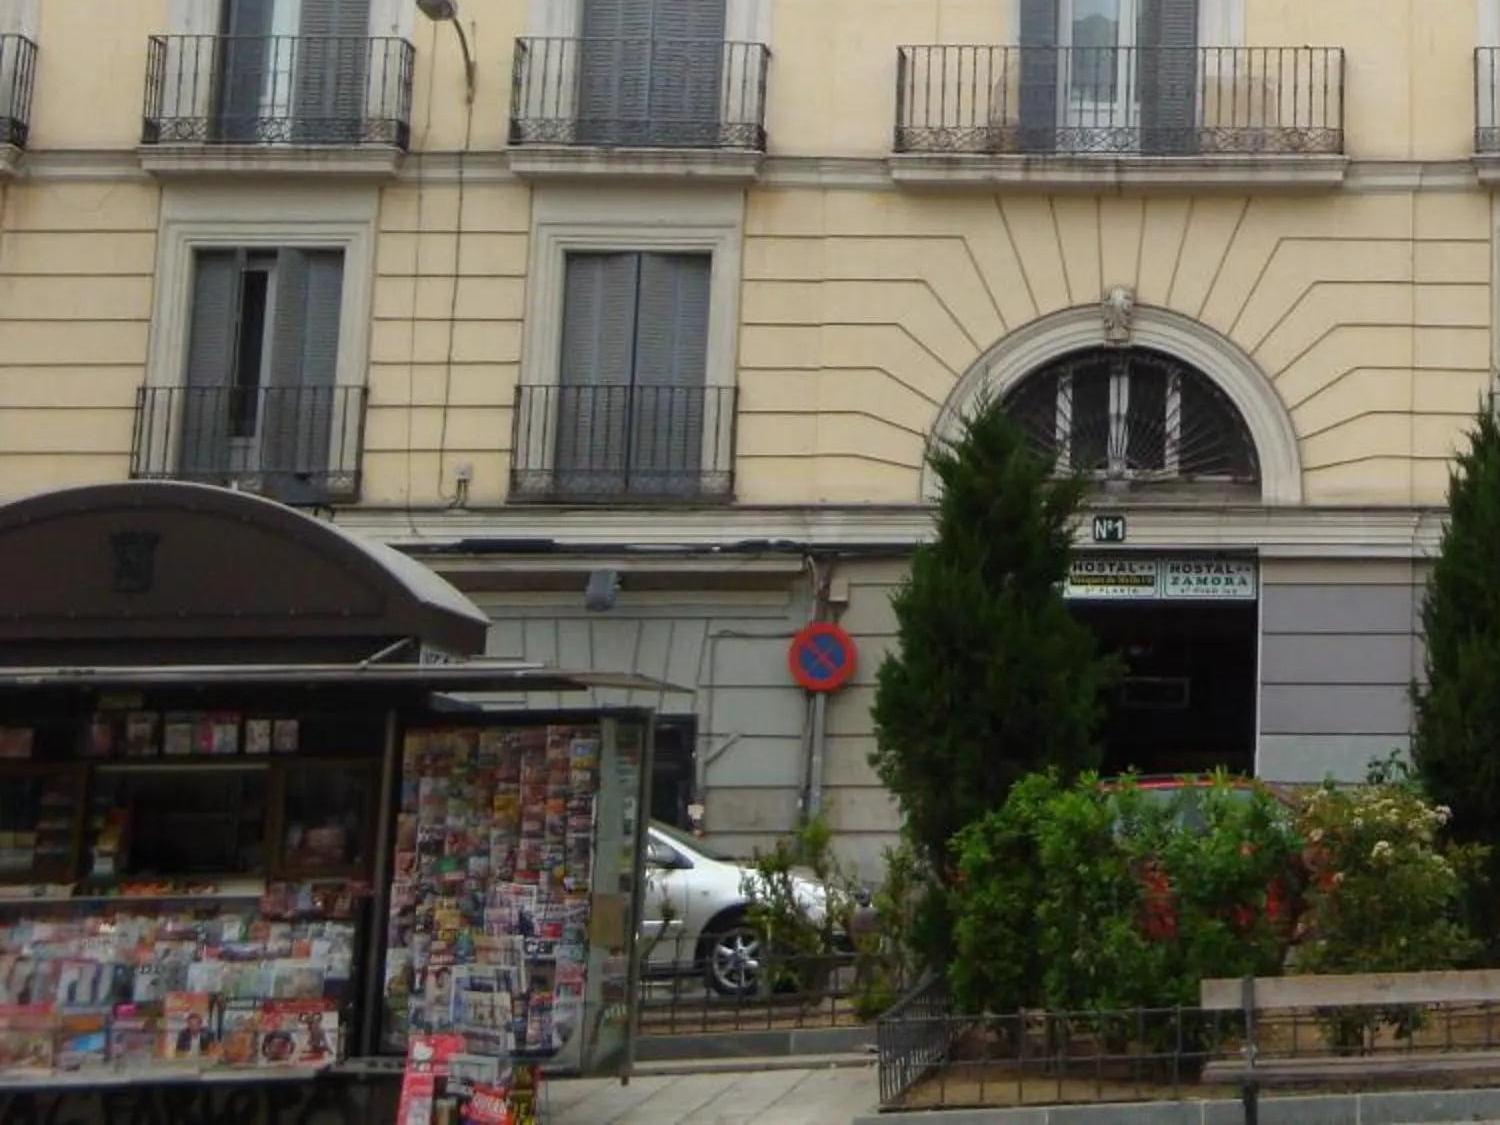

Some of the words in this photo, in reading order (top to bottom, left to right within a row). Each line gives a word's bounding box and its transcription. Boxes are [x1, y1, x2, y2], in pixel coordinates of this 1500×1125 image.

[1073, 561, 1136, 574] HOSTAL
[1169, 562, 1234, 575] HOSTAL
[1170, 575, 1249, 587] ZAMORA
